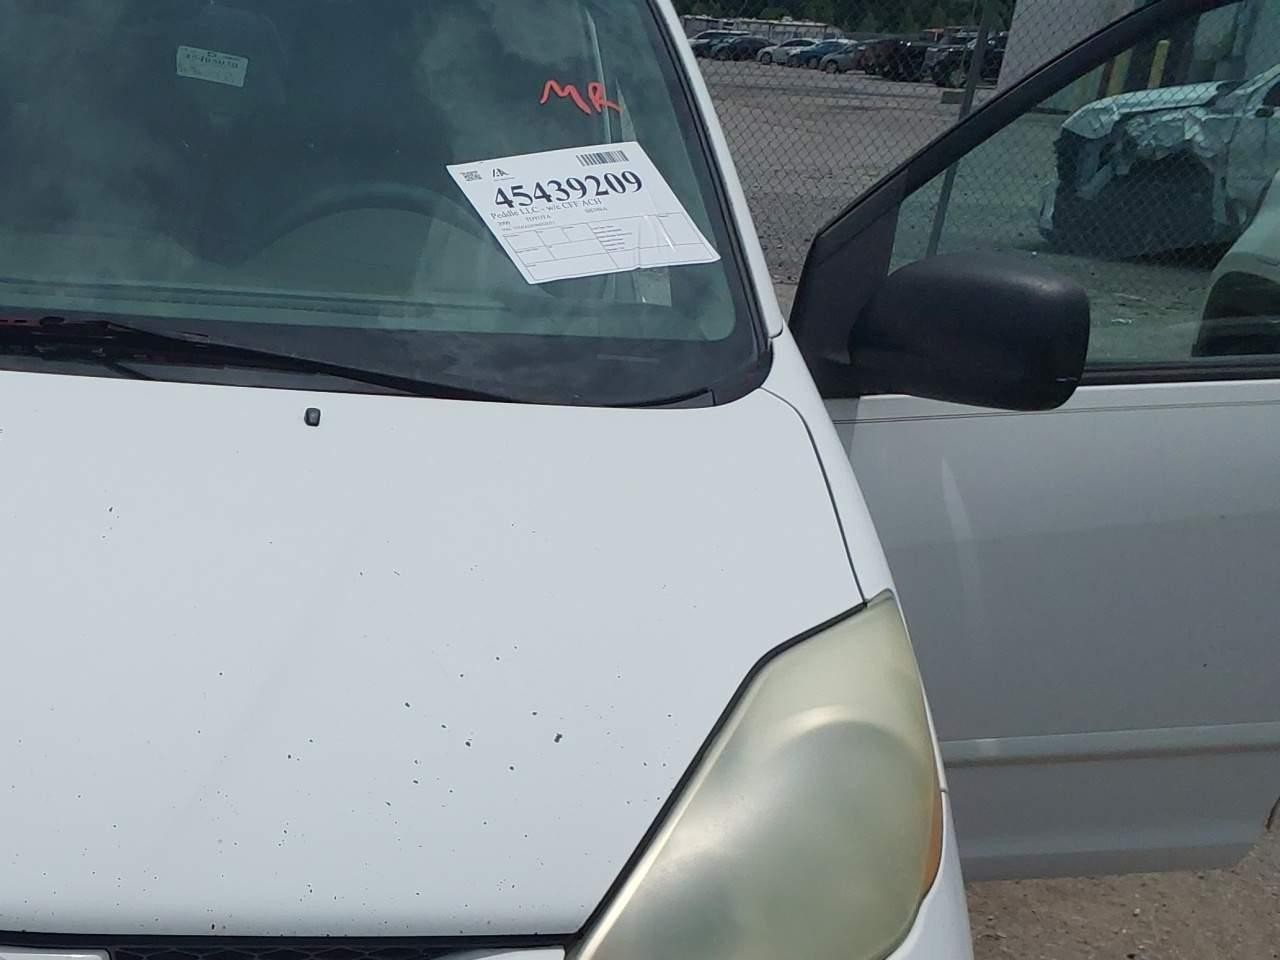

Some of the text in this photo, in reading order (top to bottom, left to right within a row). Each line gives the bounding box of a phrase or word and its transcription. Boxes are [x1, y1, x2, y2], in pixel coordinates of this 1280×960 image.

[494, 170, 643, 209] 45439209
[490, 209, 519, 220] Peddle
[519, 206, 537, 215] LLC
[582, 197, 602, 207] ACH
